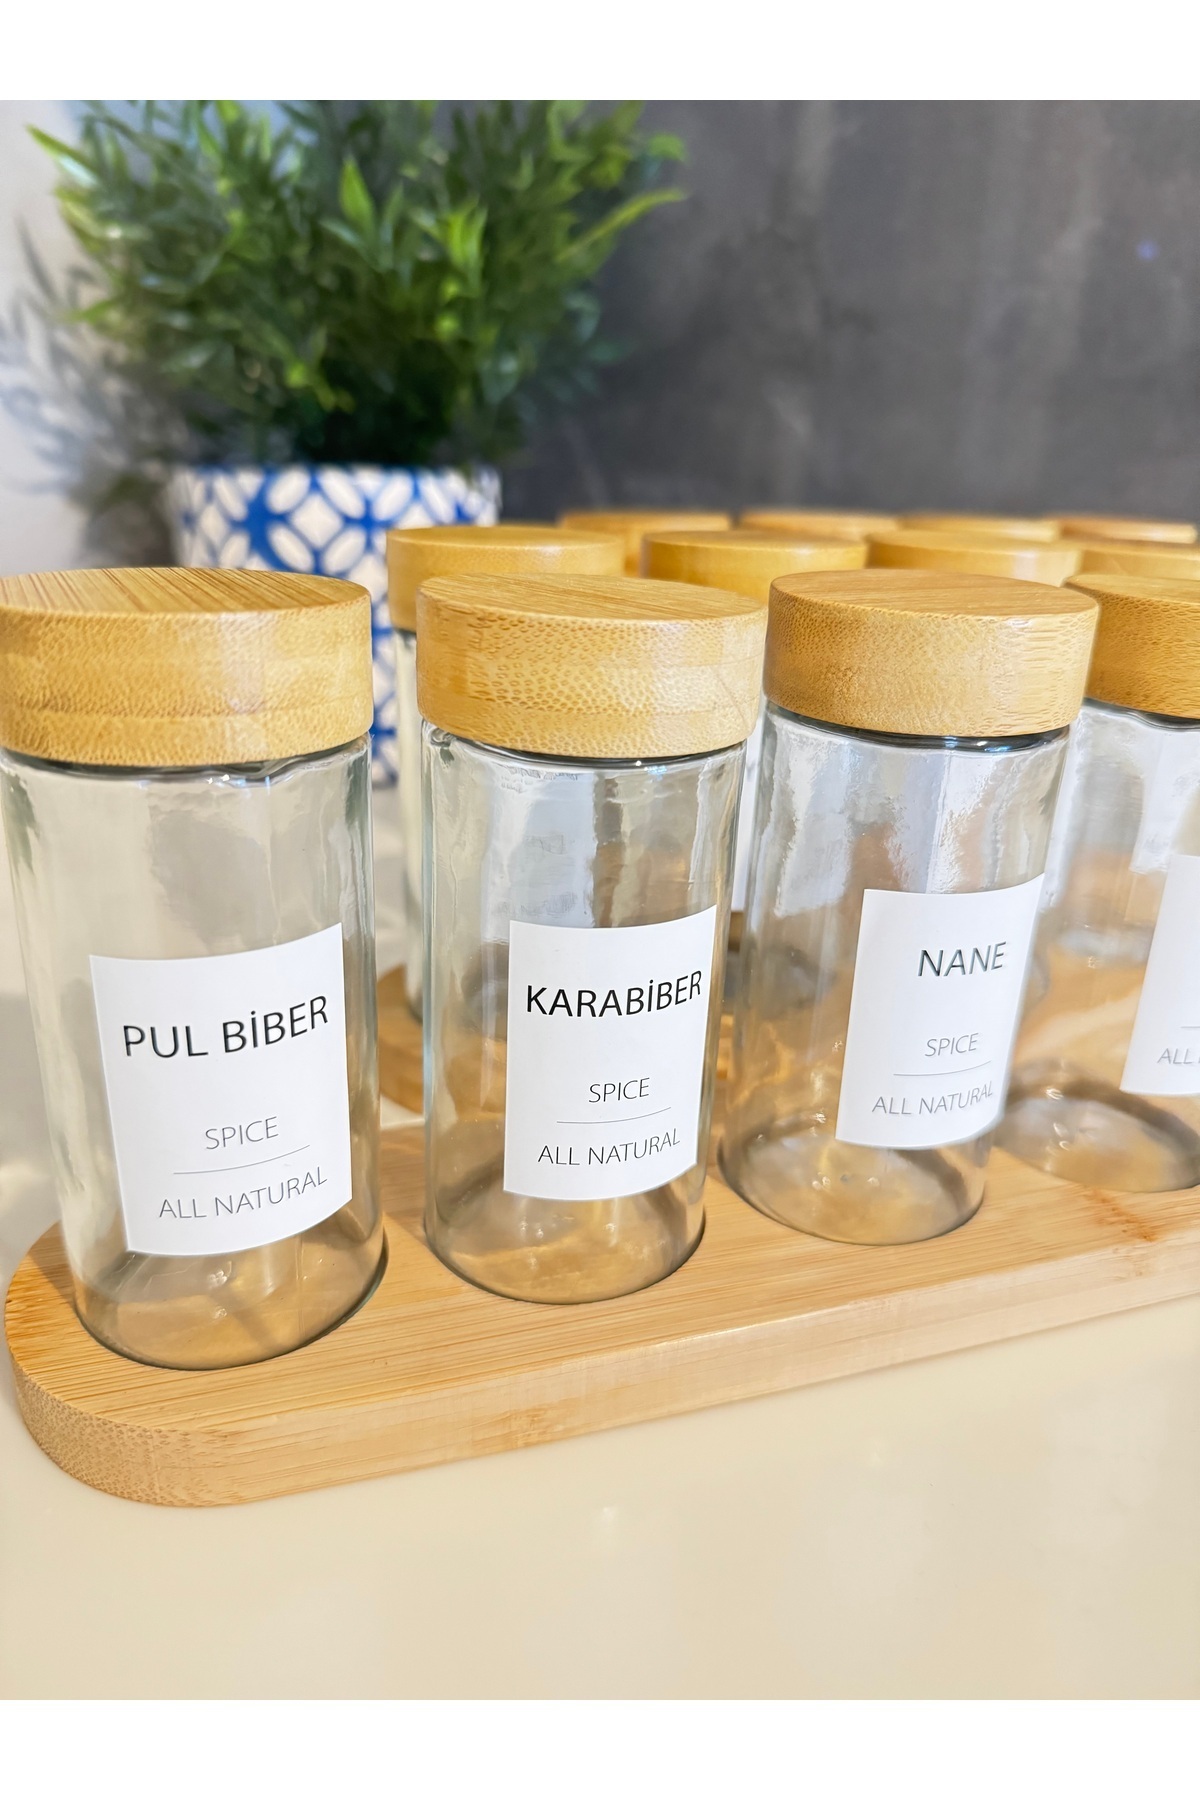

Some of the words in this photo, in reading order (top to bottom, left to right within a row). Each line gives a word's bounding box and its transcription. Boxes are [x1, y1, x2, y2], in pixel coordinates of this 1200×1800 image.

[917, 940, 1007, 977] NANE
[526, 970, 702, 1018] KARABİBER
[123, 1024, 209, 1058] PUL
[222, 995, 329, 1054] BİBER
[924, 1032, 979, 1057] SPICE
[1157, 1047, 1193, 1065] ALL
[588, 1077, 650, 1103] SPICE
[872, 1096, 912, 1115] ALL
[918, 1080, 993, 1115] NATURAL
[204, 1116, 279, 1150] SPICE
[537, 1145, 580, 1166] ALL
[588, 1128, 681, 1166] NATURAL
[158, 1199, 208, 1219] ALL
[215, 1166, 328, 1217] NATURAL
